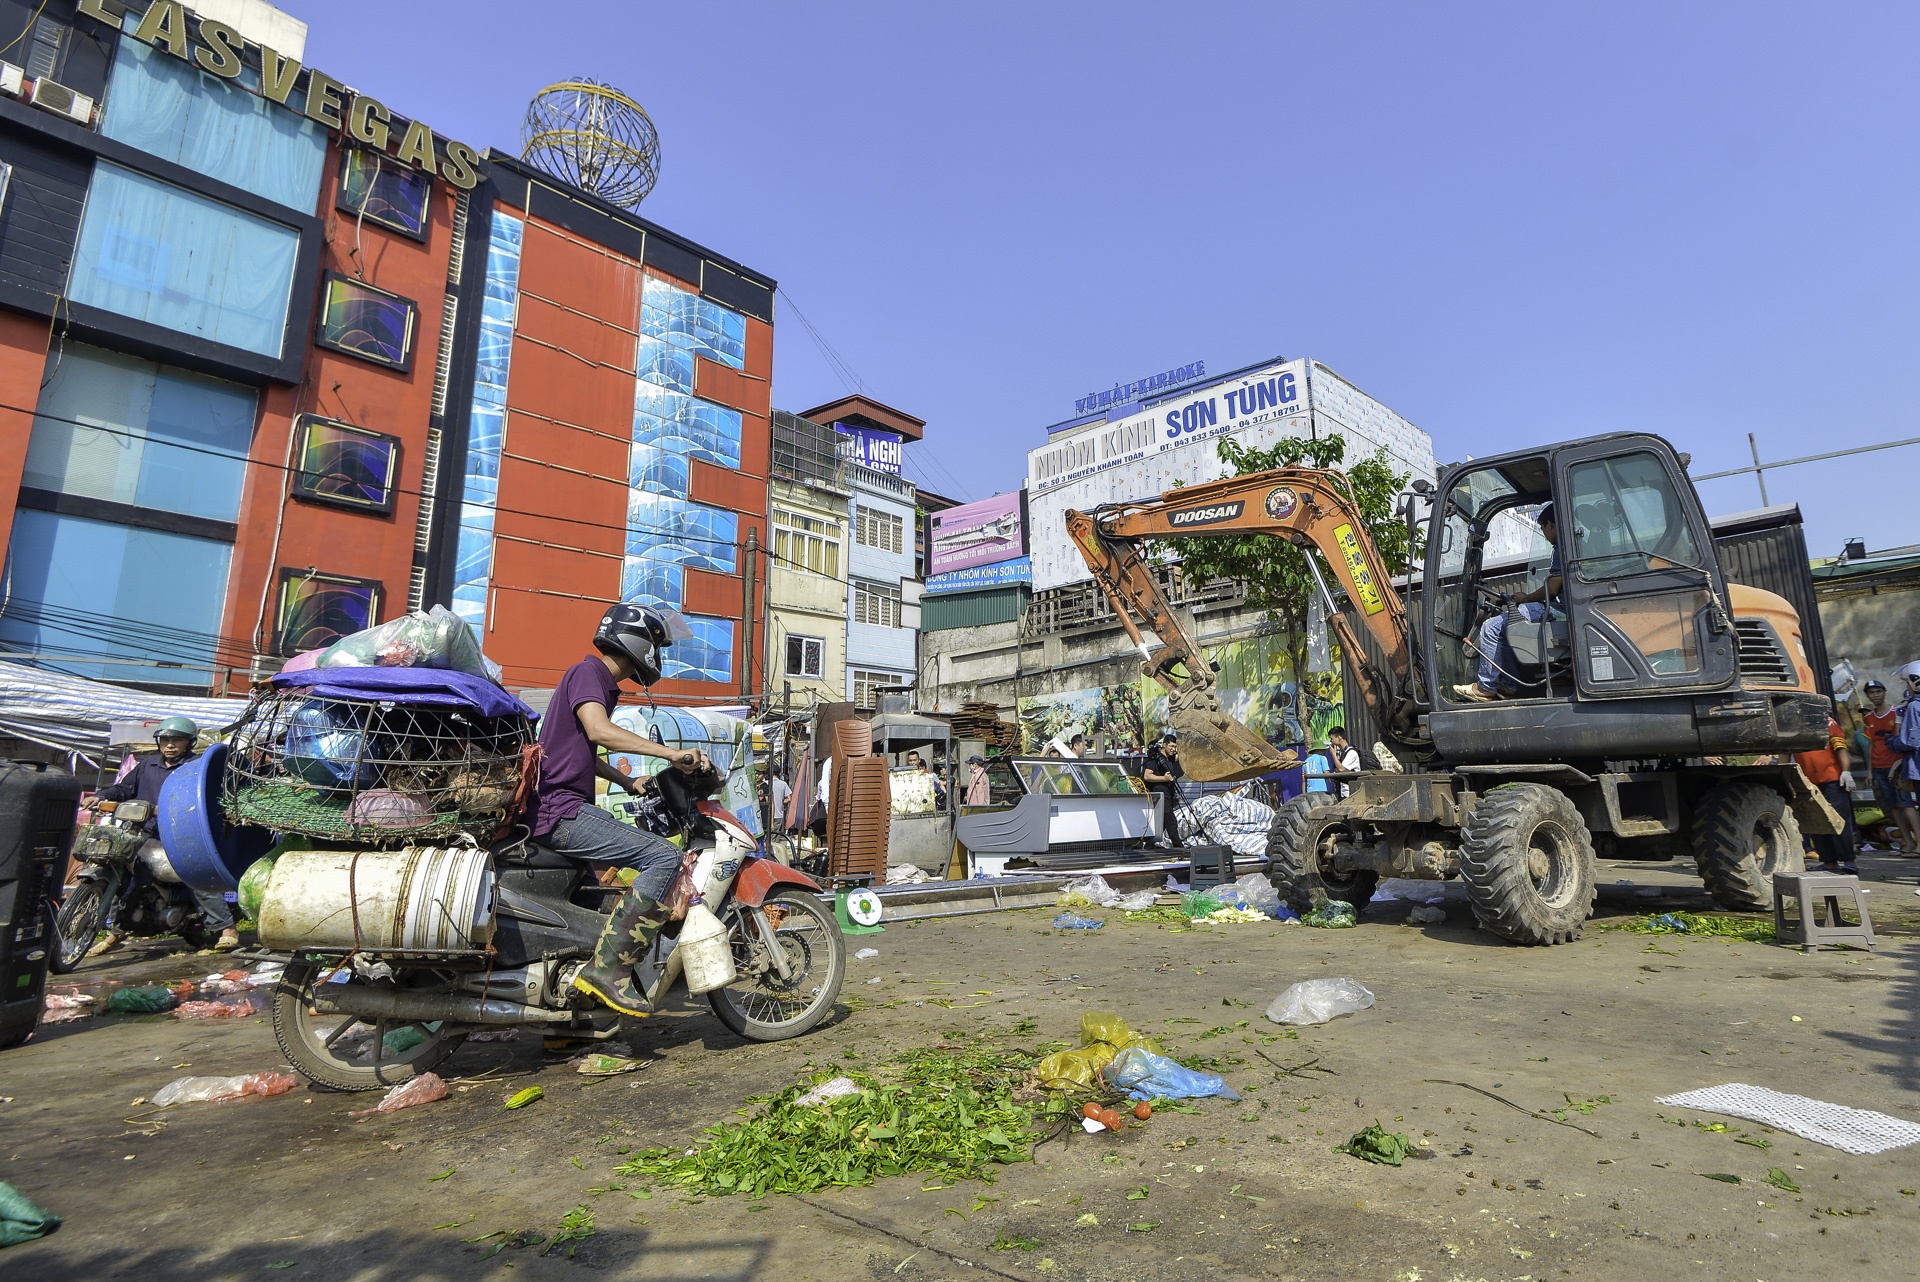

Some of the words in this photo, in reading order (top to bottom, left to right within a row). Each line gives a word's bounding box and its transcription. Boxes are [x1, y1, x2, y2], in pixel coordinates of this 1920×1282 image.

[76, 0, 245, 79] LAS
[260, 43, 479, 191] VEGAS
[1035, 438, 1096, 481] NHÔM
[1101, 418, 1156, 460] KÍNH
[1166, 397, 1217, 438] SƠN
[1223, 372, 1297, 419] TÙNG
[1174, 438, 1189, 448] 043
[1191, 433, 1207, 442] 833
[1209, 425, 1230, 436] 5400
[1239, 419, 1250, 428] 04
[1252, 411, 1269, 424] 377
[1272, 404, 1300, 418] 18791
[869, 436, 903, 465] NGHỈ
[1097, 458, 1122, 471] KHÁNH
[1124, 451, 1144, 462] TOÀN
[1174, 505, 1238, 524] DOOSAN
[949, 571, 958, 581] TY
[958, 568, 980, 580] NHÔM
[981, 566, 998, 578] KÍNH
[999, 565, 1015, 577] SƠN
